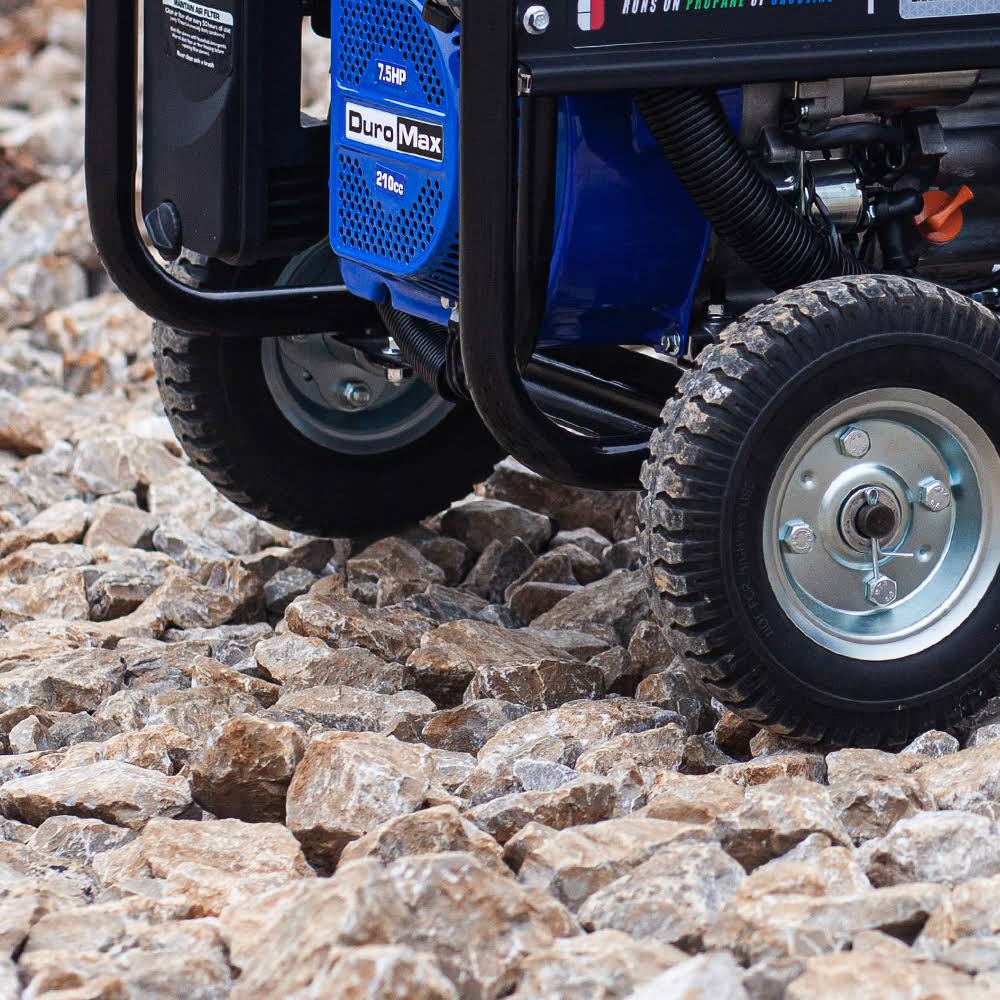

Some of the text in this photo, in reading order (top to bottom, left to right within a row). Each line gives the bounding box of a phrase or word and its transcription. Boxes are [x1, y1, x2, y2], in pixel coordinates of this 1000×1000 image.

[195, 5, 203, 15] AIR
[204, 8, 220, 20] FILTER
[378, 63, 407, 86] 7.5HP
[376, 171, 404, 195] 210cc
